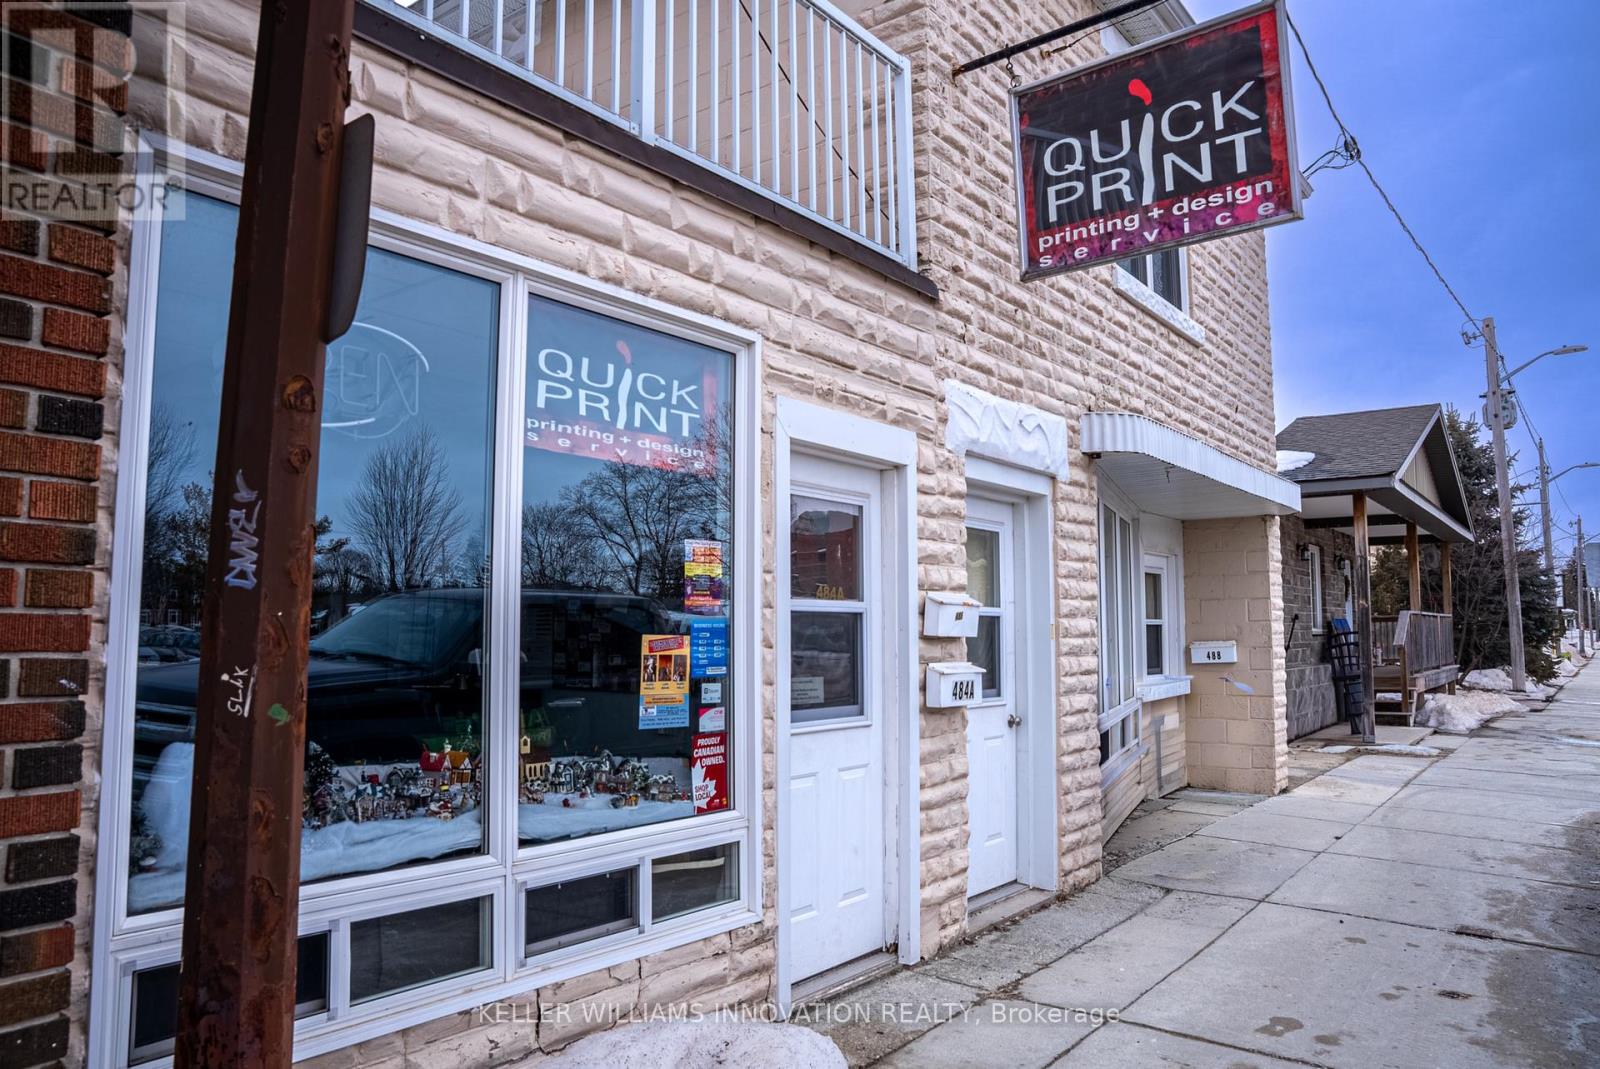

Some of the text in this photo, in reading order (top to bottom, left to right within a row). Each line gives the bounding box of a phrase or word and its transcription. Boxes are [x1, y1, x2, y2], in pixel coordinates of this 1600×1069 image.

[1043, 79, 1260, 178] QUICK
[1047, 127, 1262, 222] PRINT
[1039, 212, 1140, 252] printing
[1172, 180, 1273, 216] design
[1039, 202, 1275, 267] service
[538, 340, 700, 410] QUICK
[536, 379, 700, 437] PRINT
[527, 417, 614, 444] printing
[637, 438, 704, 458] design
[527, 432, 705, 469] service
[815, 585, 845, 600] 484A
[1206, 650, 1222, 661] 488
[952, 680, 974, 700] 484A
[693, 745, 725, 757] CANADIAN
[697, 736, 721, 747] PROUDLY
[694, 785, 709, 793] SHOP
